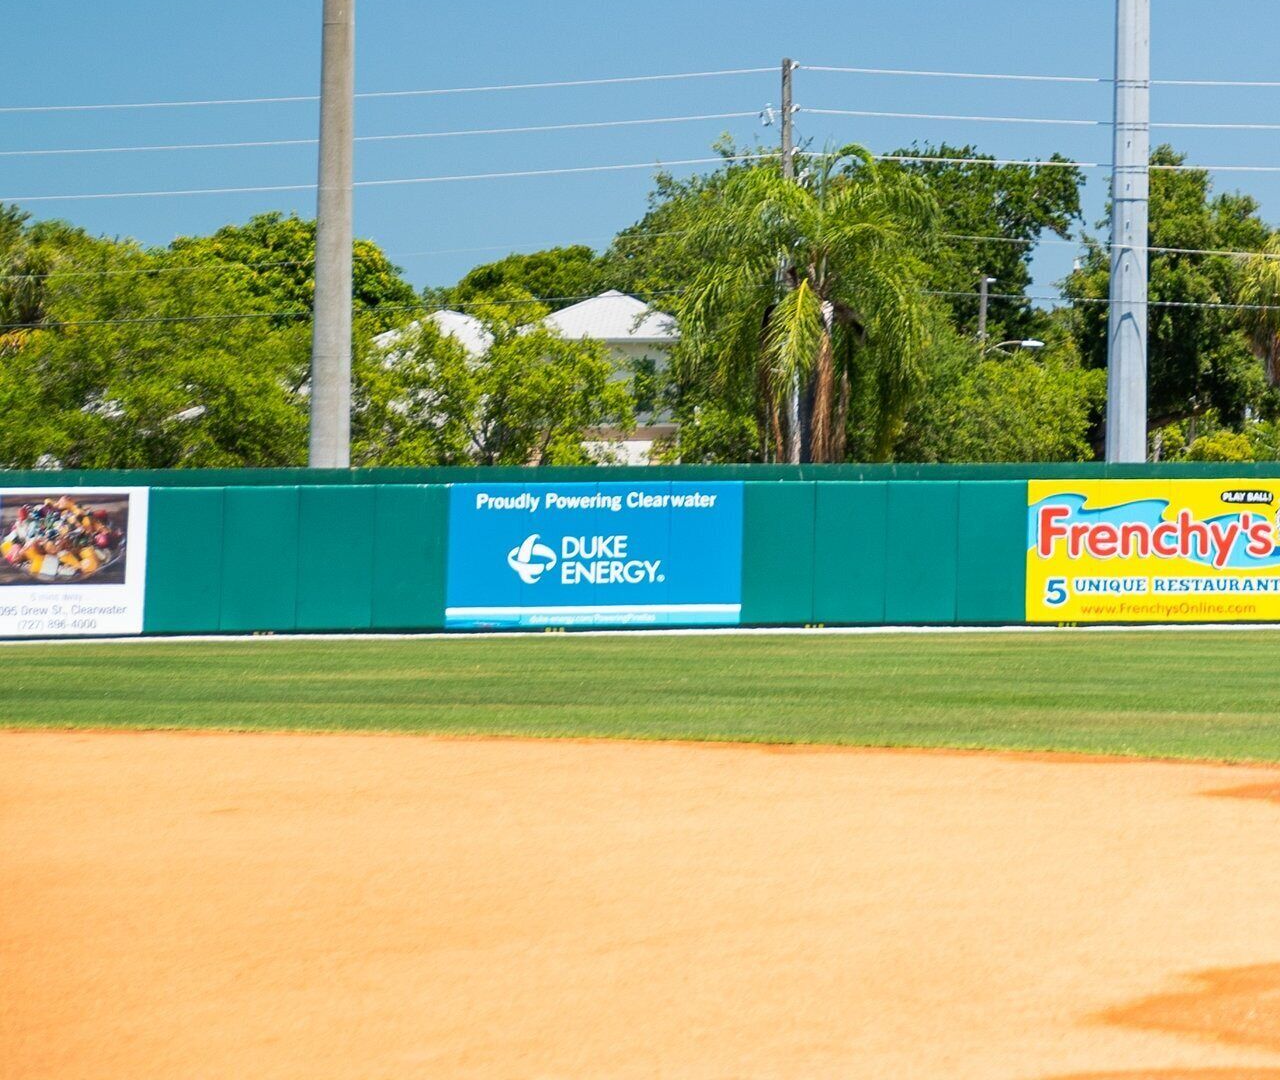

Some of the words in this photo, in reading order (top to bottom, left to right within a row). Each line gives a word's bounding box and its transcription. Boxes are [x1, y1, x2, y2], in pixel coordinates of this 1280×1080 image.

[476, 492, 540, 512] Proudly
[545, 492, 622, 512] Powering
[626, 491, 717, 509] Clearwater
[1222, 491, 1246, 503] PLAY
[1246, 491, 1273, 503] BALL!
[1036, 506, 1274, 569] Frenchy's
[561, 535, 628, 559] DUKE
[1046, 579, 1067, 605] 5
[1074, 578, 1147, 593] UNIQUE
[21, 605, 49, 616] Drew
[71, 604, 128, 615] Clearwater
[1081, 602, 1256, 617] www.FrenchysOnline.com
[18, 619, 44, 630] (727)
